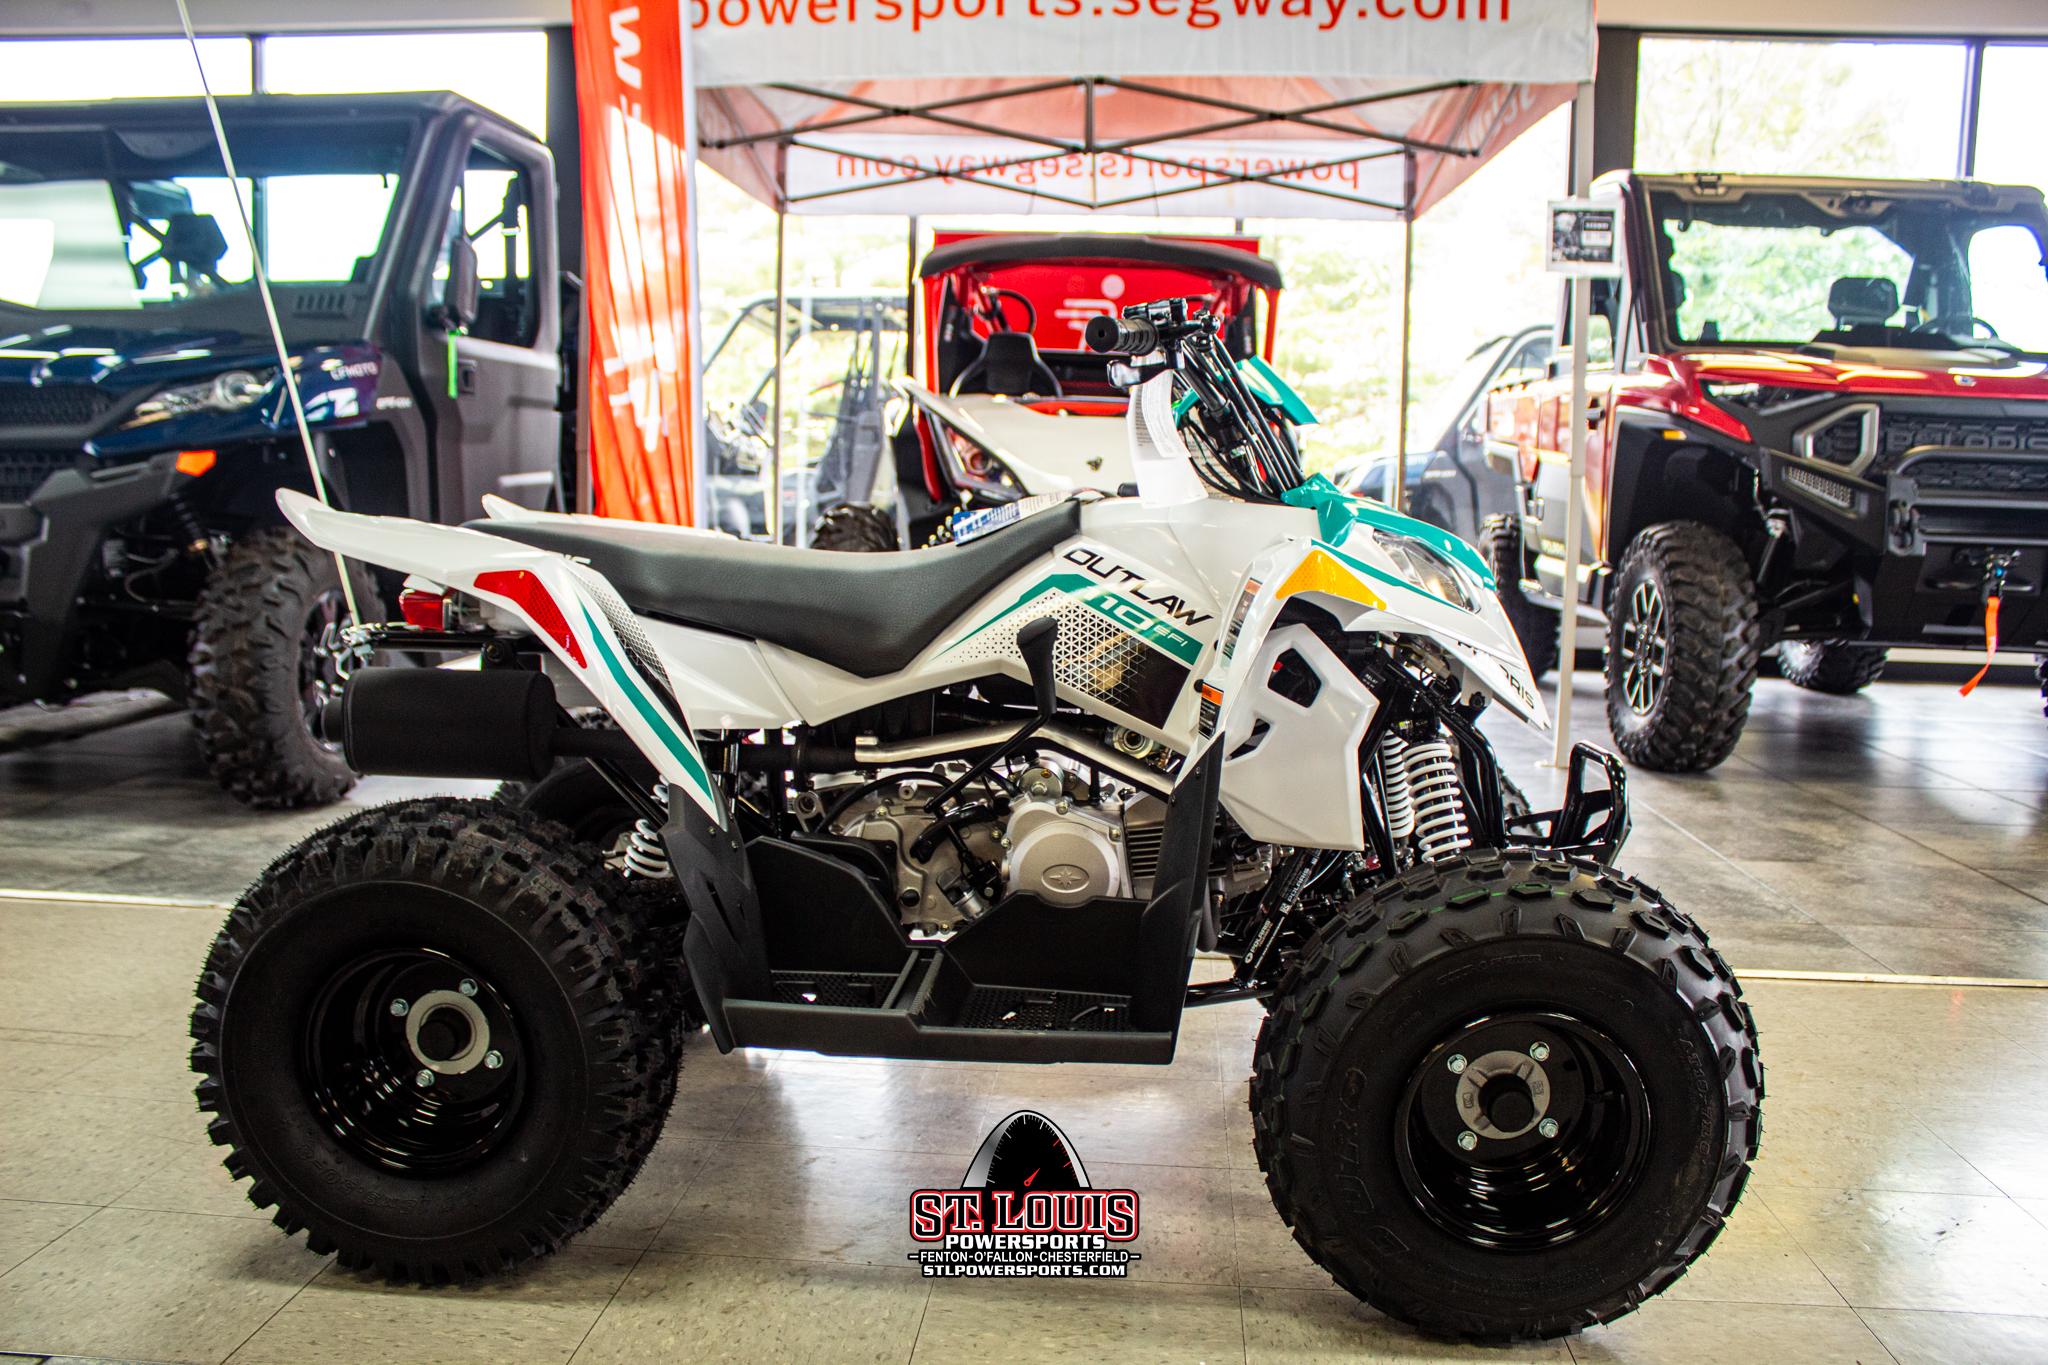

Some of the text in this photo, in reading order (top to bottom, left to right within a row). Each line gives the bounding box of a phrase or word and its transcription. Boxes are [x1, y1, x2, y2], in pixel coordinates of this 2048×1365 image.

[1063, 548, 1214, 626] OUTLAW
[1083, 586, 1154, 631] 110
[1153, 624, 1188, 647] EFI
